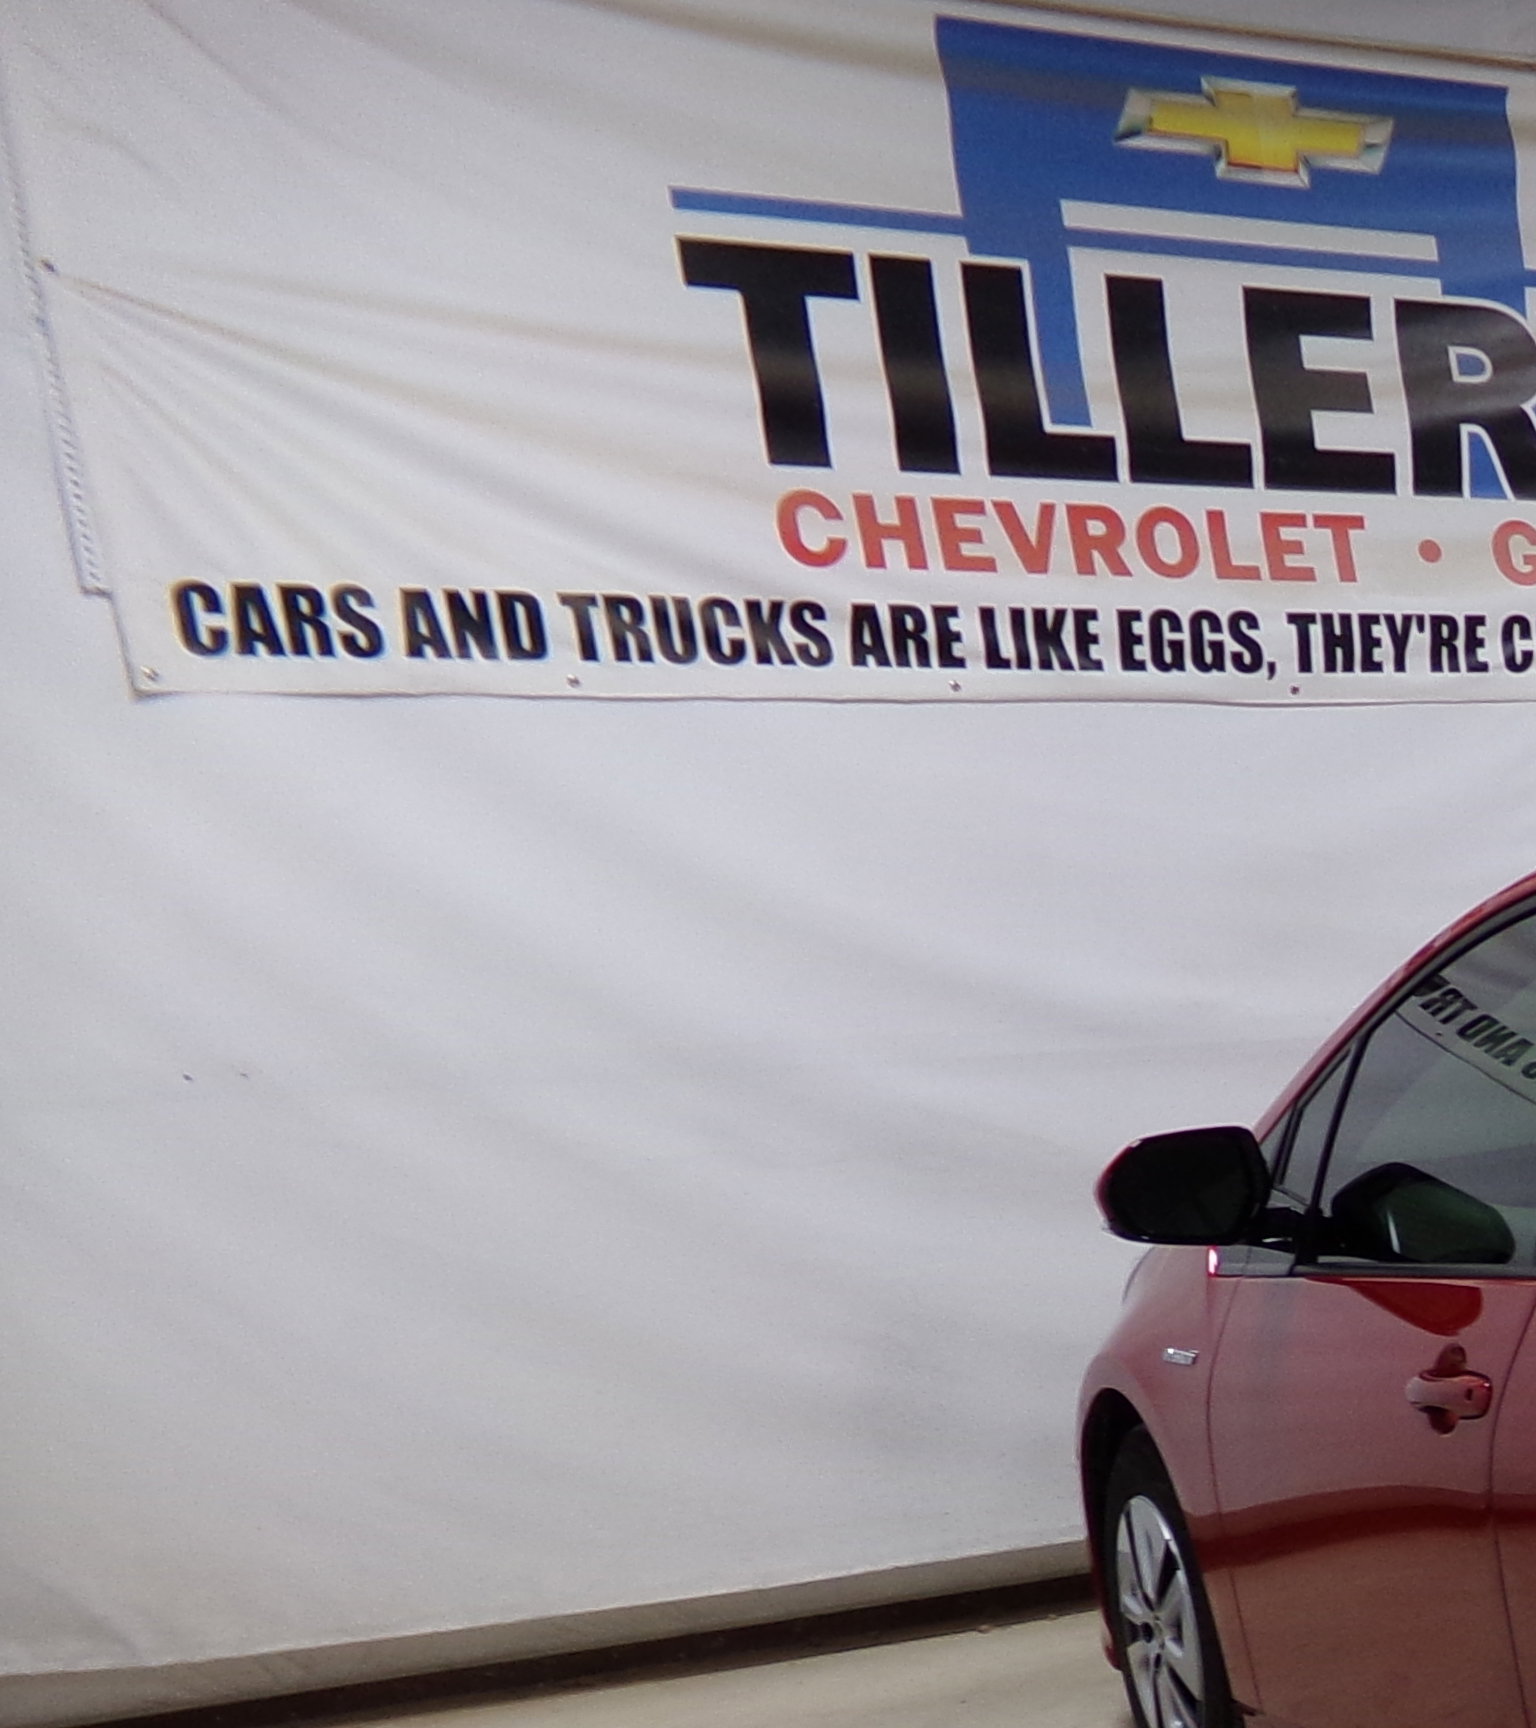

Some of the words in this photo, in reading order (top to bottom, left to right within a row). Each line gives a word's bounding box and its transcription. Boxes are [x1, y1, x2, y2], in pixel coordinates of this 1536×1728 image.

[775, 488, 1367, 582] CHEVROLET
[174, 580, 382, 658] CARS
[399, 587, 547, 661] AND
[556, 590, 834, 668] TRUCKS
[849, 603, 967, 669] ARE
[979, 606, 1103, 671] LIKE
[1115, 608, 1276, 679] EGGS,
[1286, 612, 1488, 674] THEY'RE
